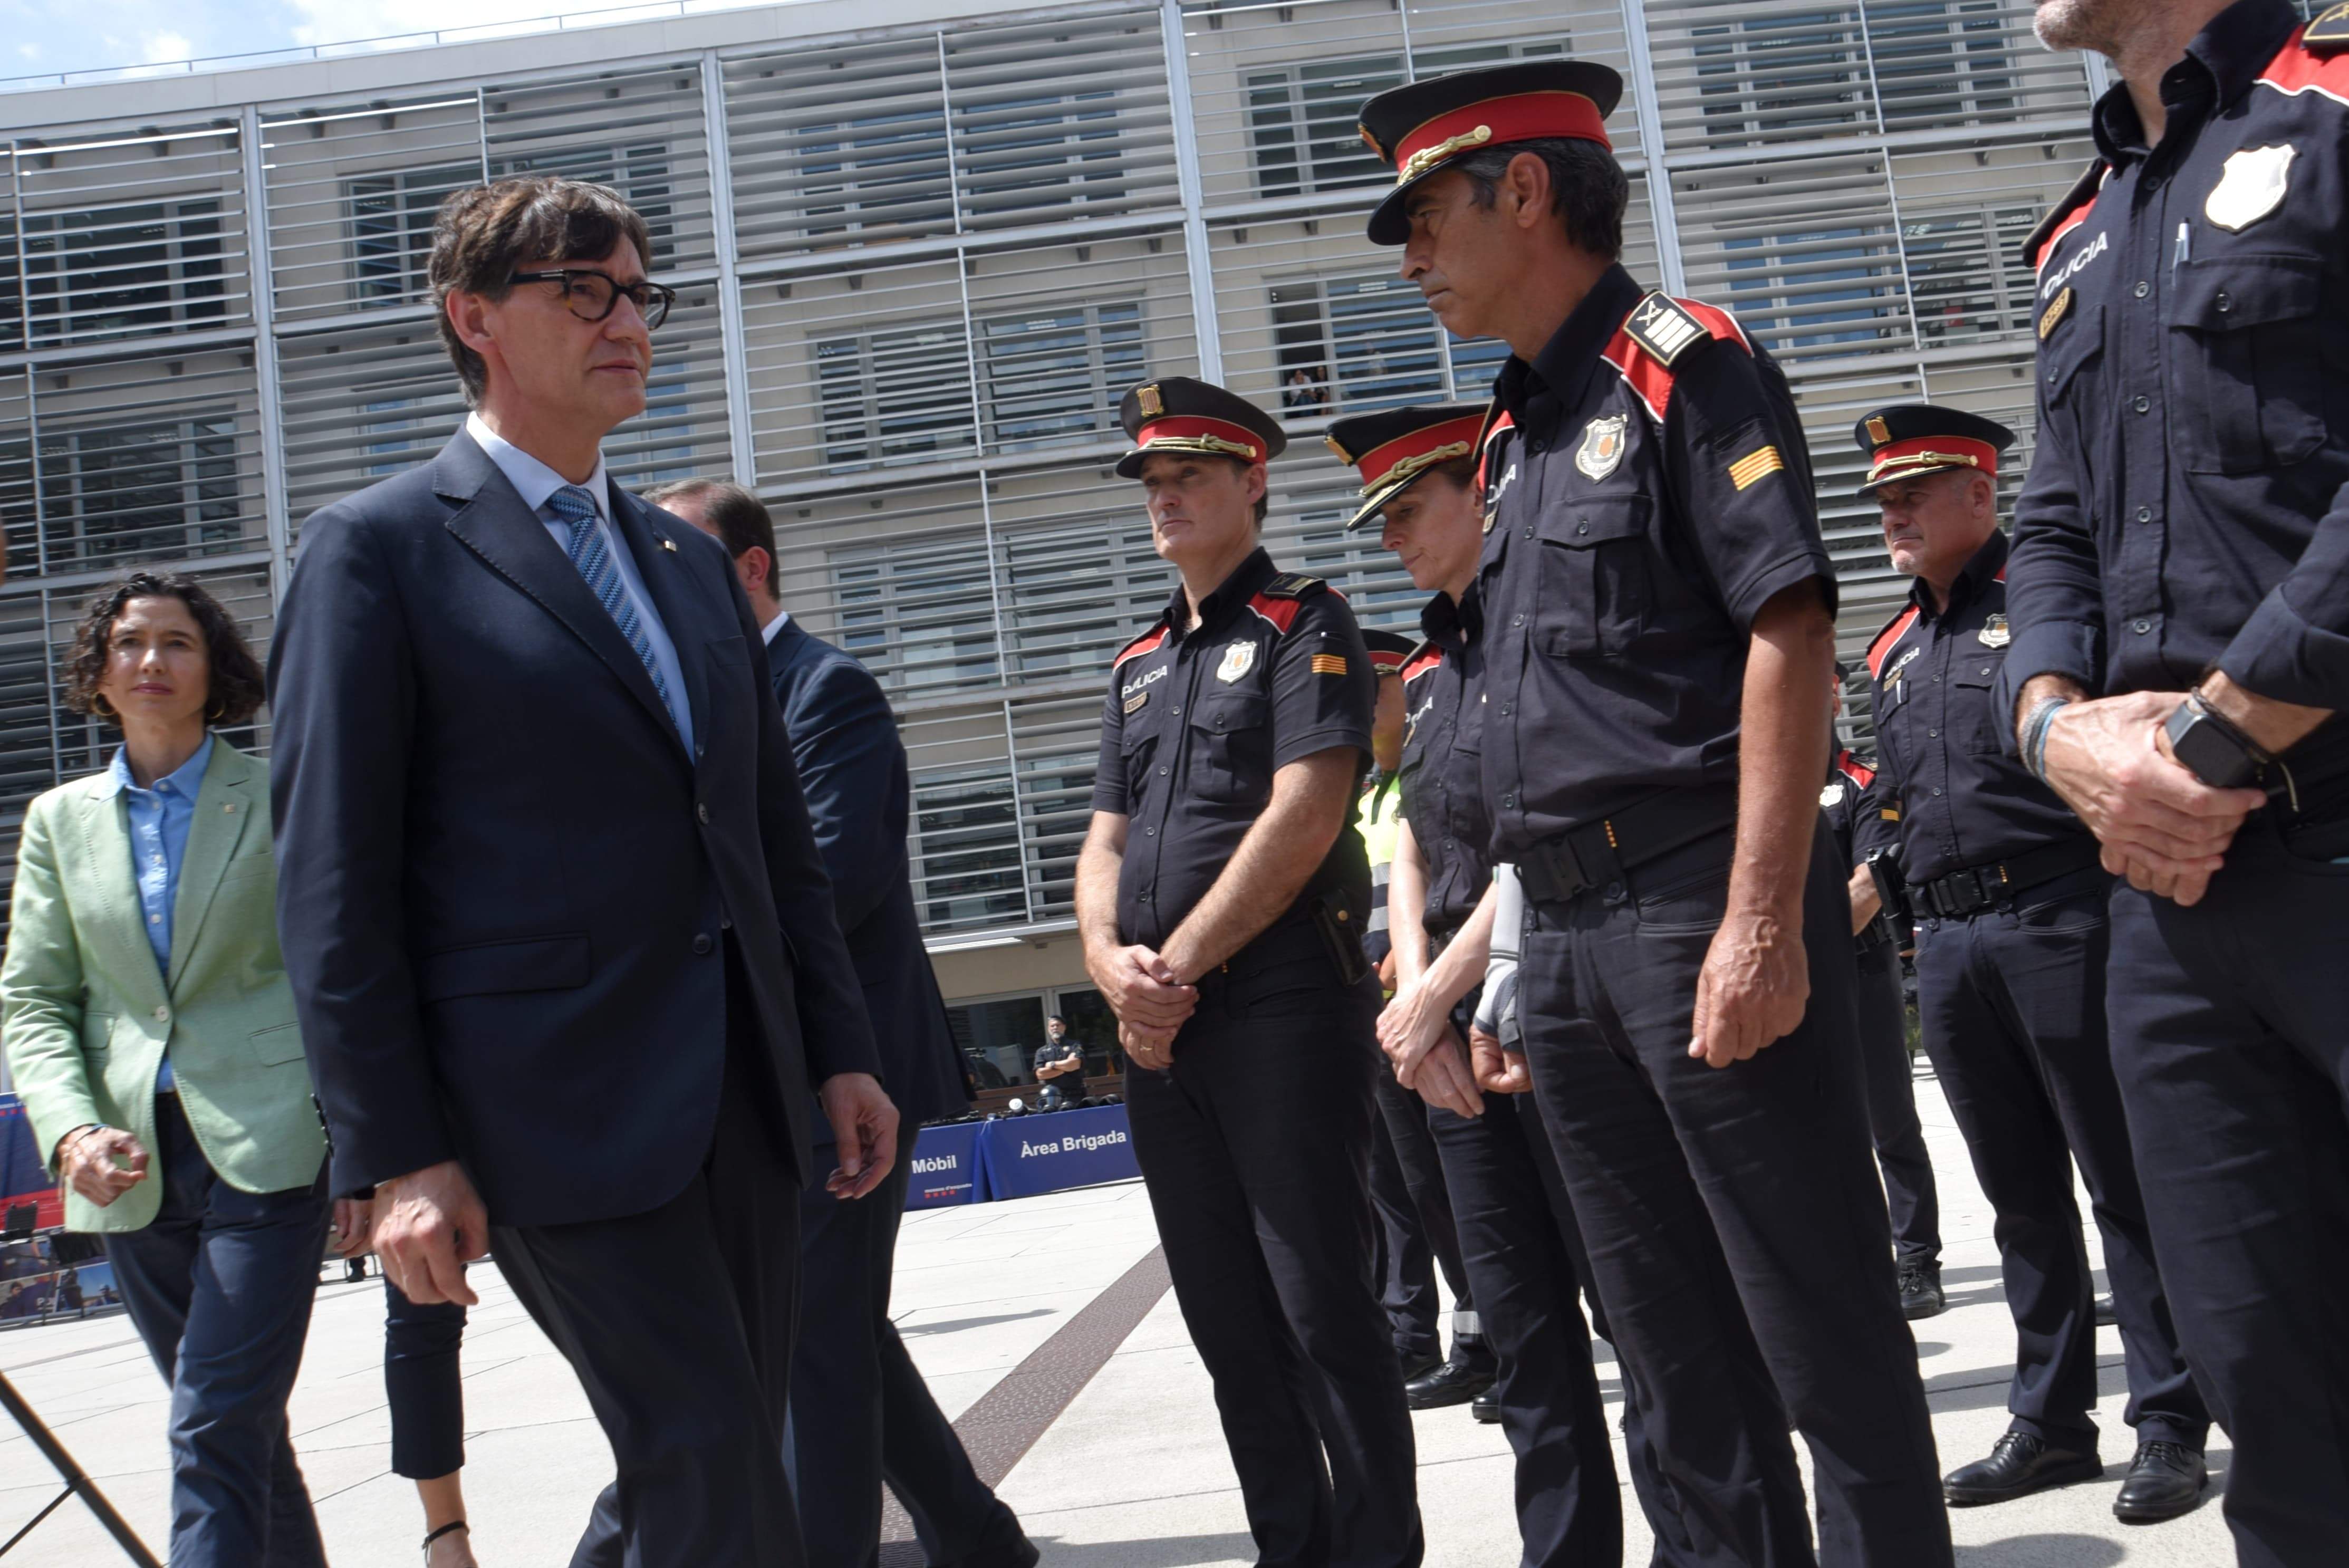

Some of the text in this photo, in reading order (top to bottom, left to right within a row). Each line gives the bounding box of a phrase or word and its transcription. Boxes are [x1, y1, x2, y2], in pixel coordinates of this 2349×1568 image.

[1021, 1130, 1127, 1158] Àrea Brigada
[911, 1155, 957, 1174] Mòbil
